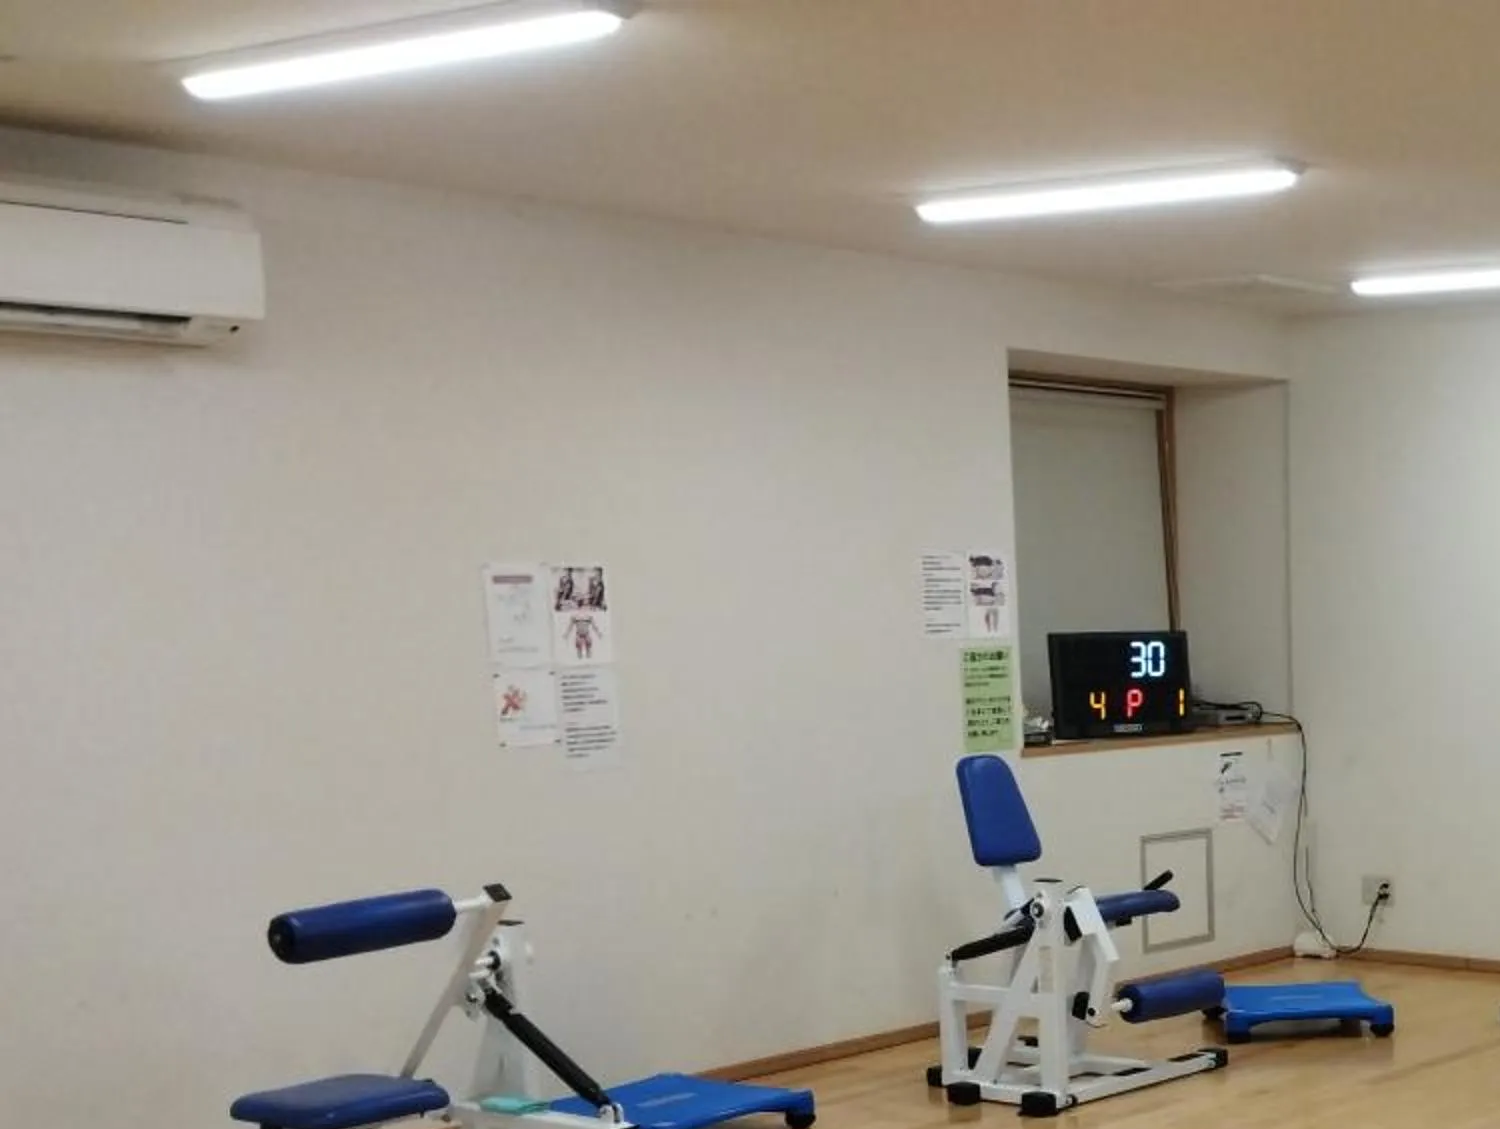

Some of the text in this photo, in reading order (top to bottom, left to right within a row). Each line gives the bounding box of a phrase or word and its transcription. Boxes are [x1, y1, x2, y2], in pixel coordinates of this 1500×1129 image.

[1130, 641, 1165, 678] 30
[1089, 687, 1186, 720] 4 P 1
